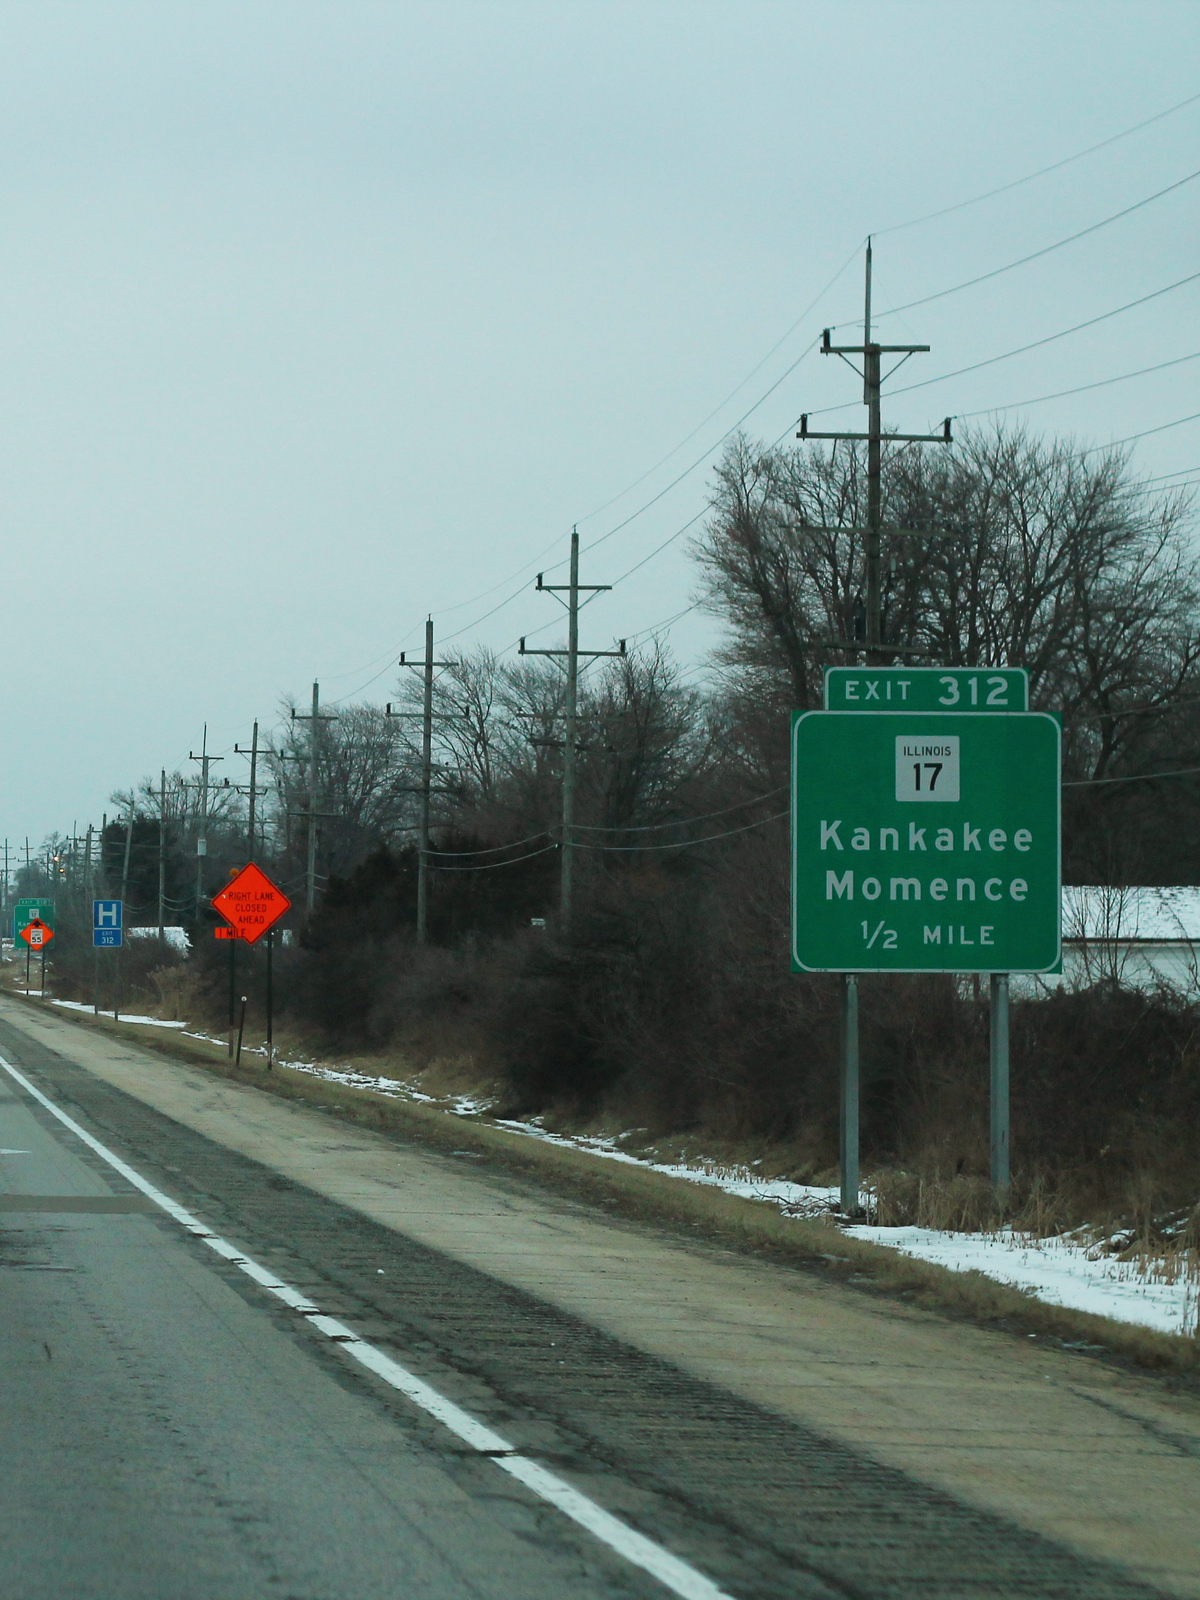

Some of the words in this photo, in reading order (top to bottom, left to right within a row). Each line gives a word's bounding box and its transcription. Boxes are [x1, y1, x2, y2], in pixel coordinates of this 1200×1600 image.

[845, 680, 911, 700] EXIT
[938, 676, 1008, 705] 312
[903, 746, 951, 756] ILLINOIS
[913, 763, 943, 791] 17
[820, 820, 1033, 851] Kankakee
[826, 870, 1029, 900] Momence
[228, 892, 251, 900] RIGHT
[254, 892, 275, 901] LANE
[98, 903, 117, 926] H
[235, 903, 267, 912] CLOSED
[238, 915, 265, 924] AHEAD
[226, 928, 246, 938] MILE
[923, 925, 995, 944] MILE
